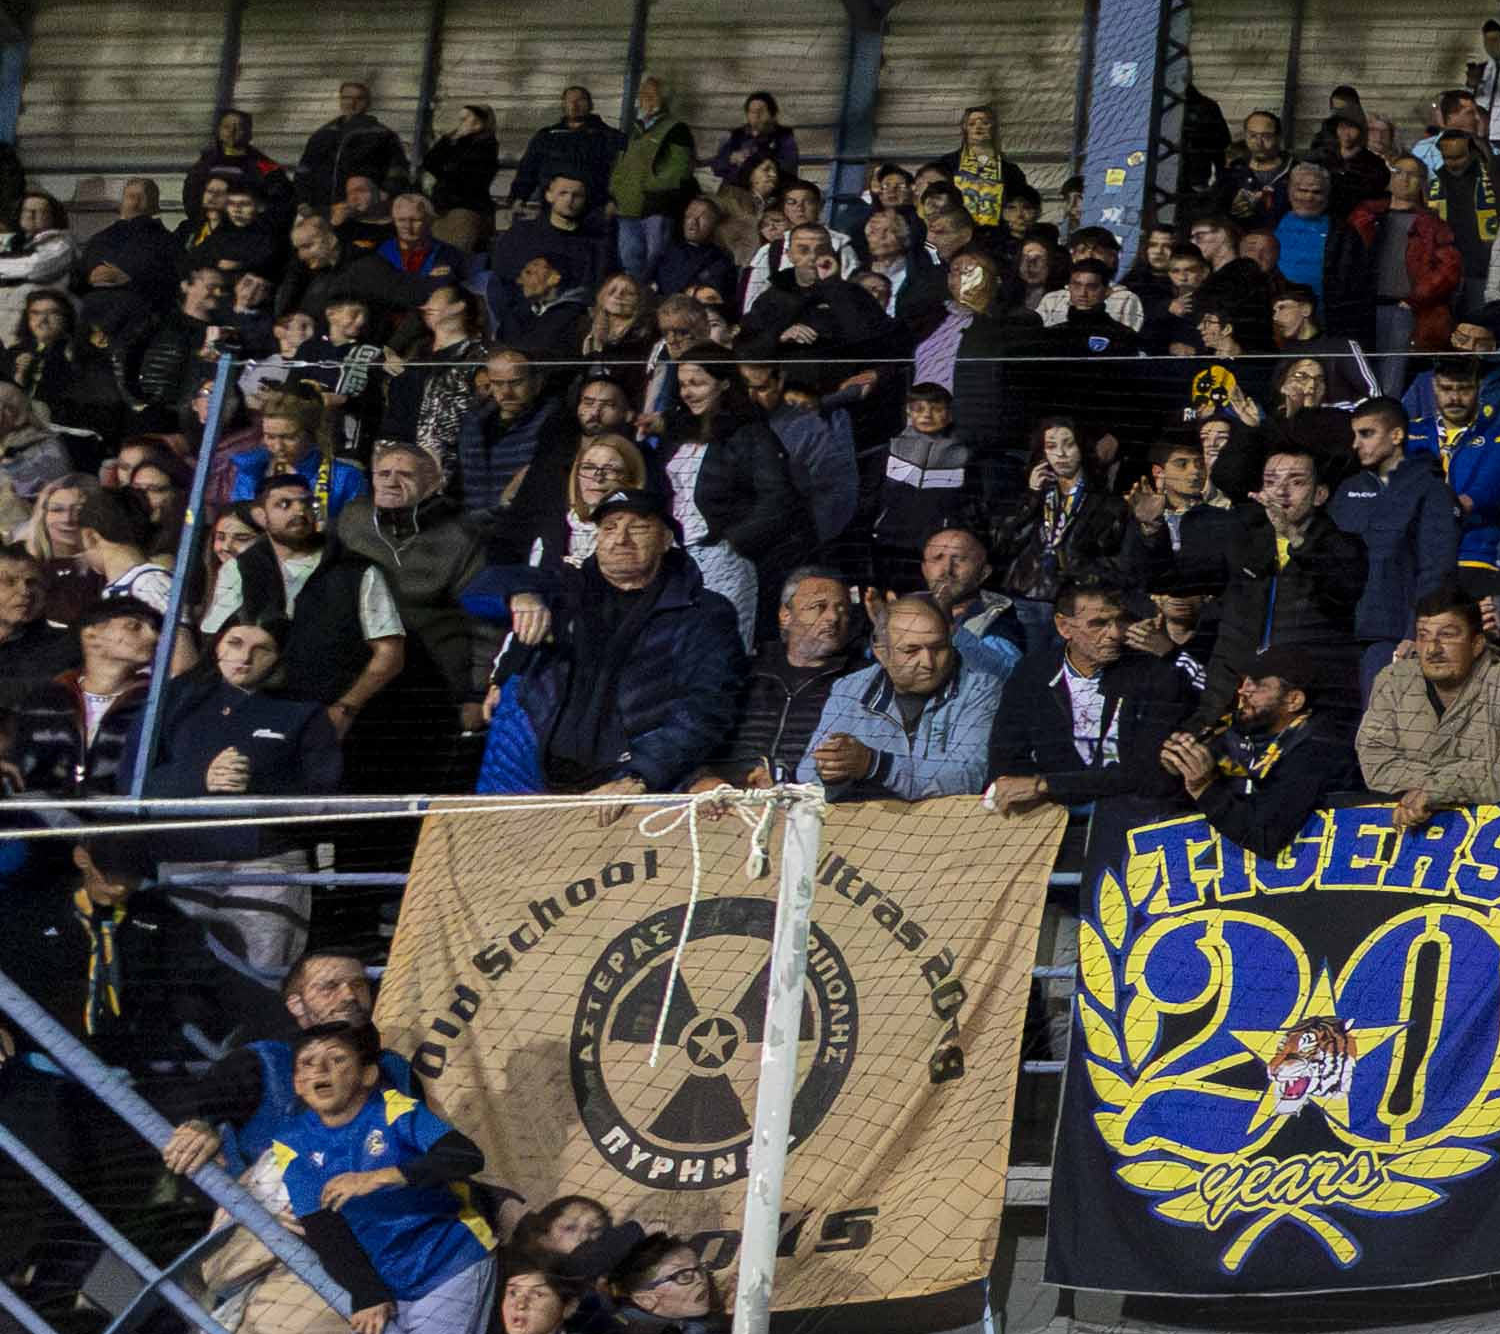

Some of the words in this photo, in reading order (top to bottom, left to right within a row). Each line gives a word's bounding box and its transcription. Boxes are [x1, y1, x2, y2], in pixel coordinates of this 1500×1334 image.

[412, 984, 481, 1079] Old
[472, 847, 660, 980] School
[813, 851, 929, 952] ltras
[579, 921, 674, 1063] ΑΣΤΕΡΑΣ
[805, 933, 851, 1065] ΡΙΠΟΛΗΣ
[600, 1125, 797, 1183] ΠΥΡΗΝ
[1197, 1150, 1390, 1229] years
